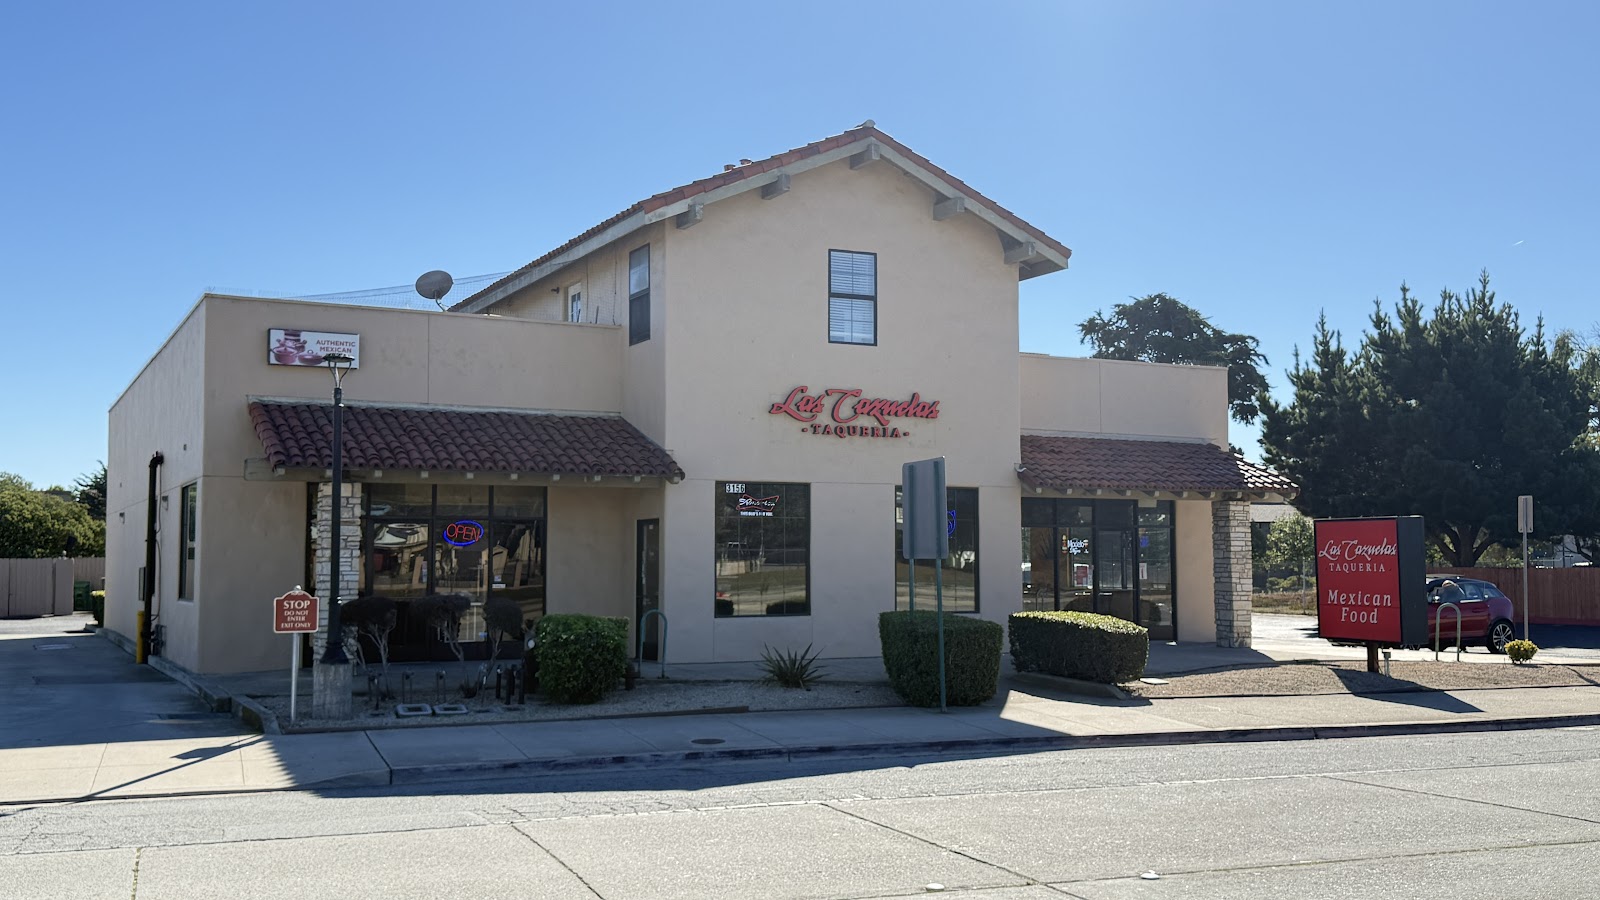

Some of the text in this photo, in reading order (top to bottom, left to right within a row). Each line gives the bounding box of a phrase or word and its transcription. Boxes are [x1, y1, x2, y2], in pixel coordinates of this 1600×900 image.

[316, 339, 356, 347] AUTHENTIC
[768, 385, 941, 427] Las Cazuelas
[725, 483, 746, 493] 3156
[446, 523, 481, 542] OPEN
[1318, 537, 1397, 561] Las Cazuelas
[1328, 562, 1386, 573] TAQUERIA
[283, 600, 311, 610] STOP
[1327, 589, 1392, 607] Mexican
[1340, 606, 1379, 624] Food
